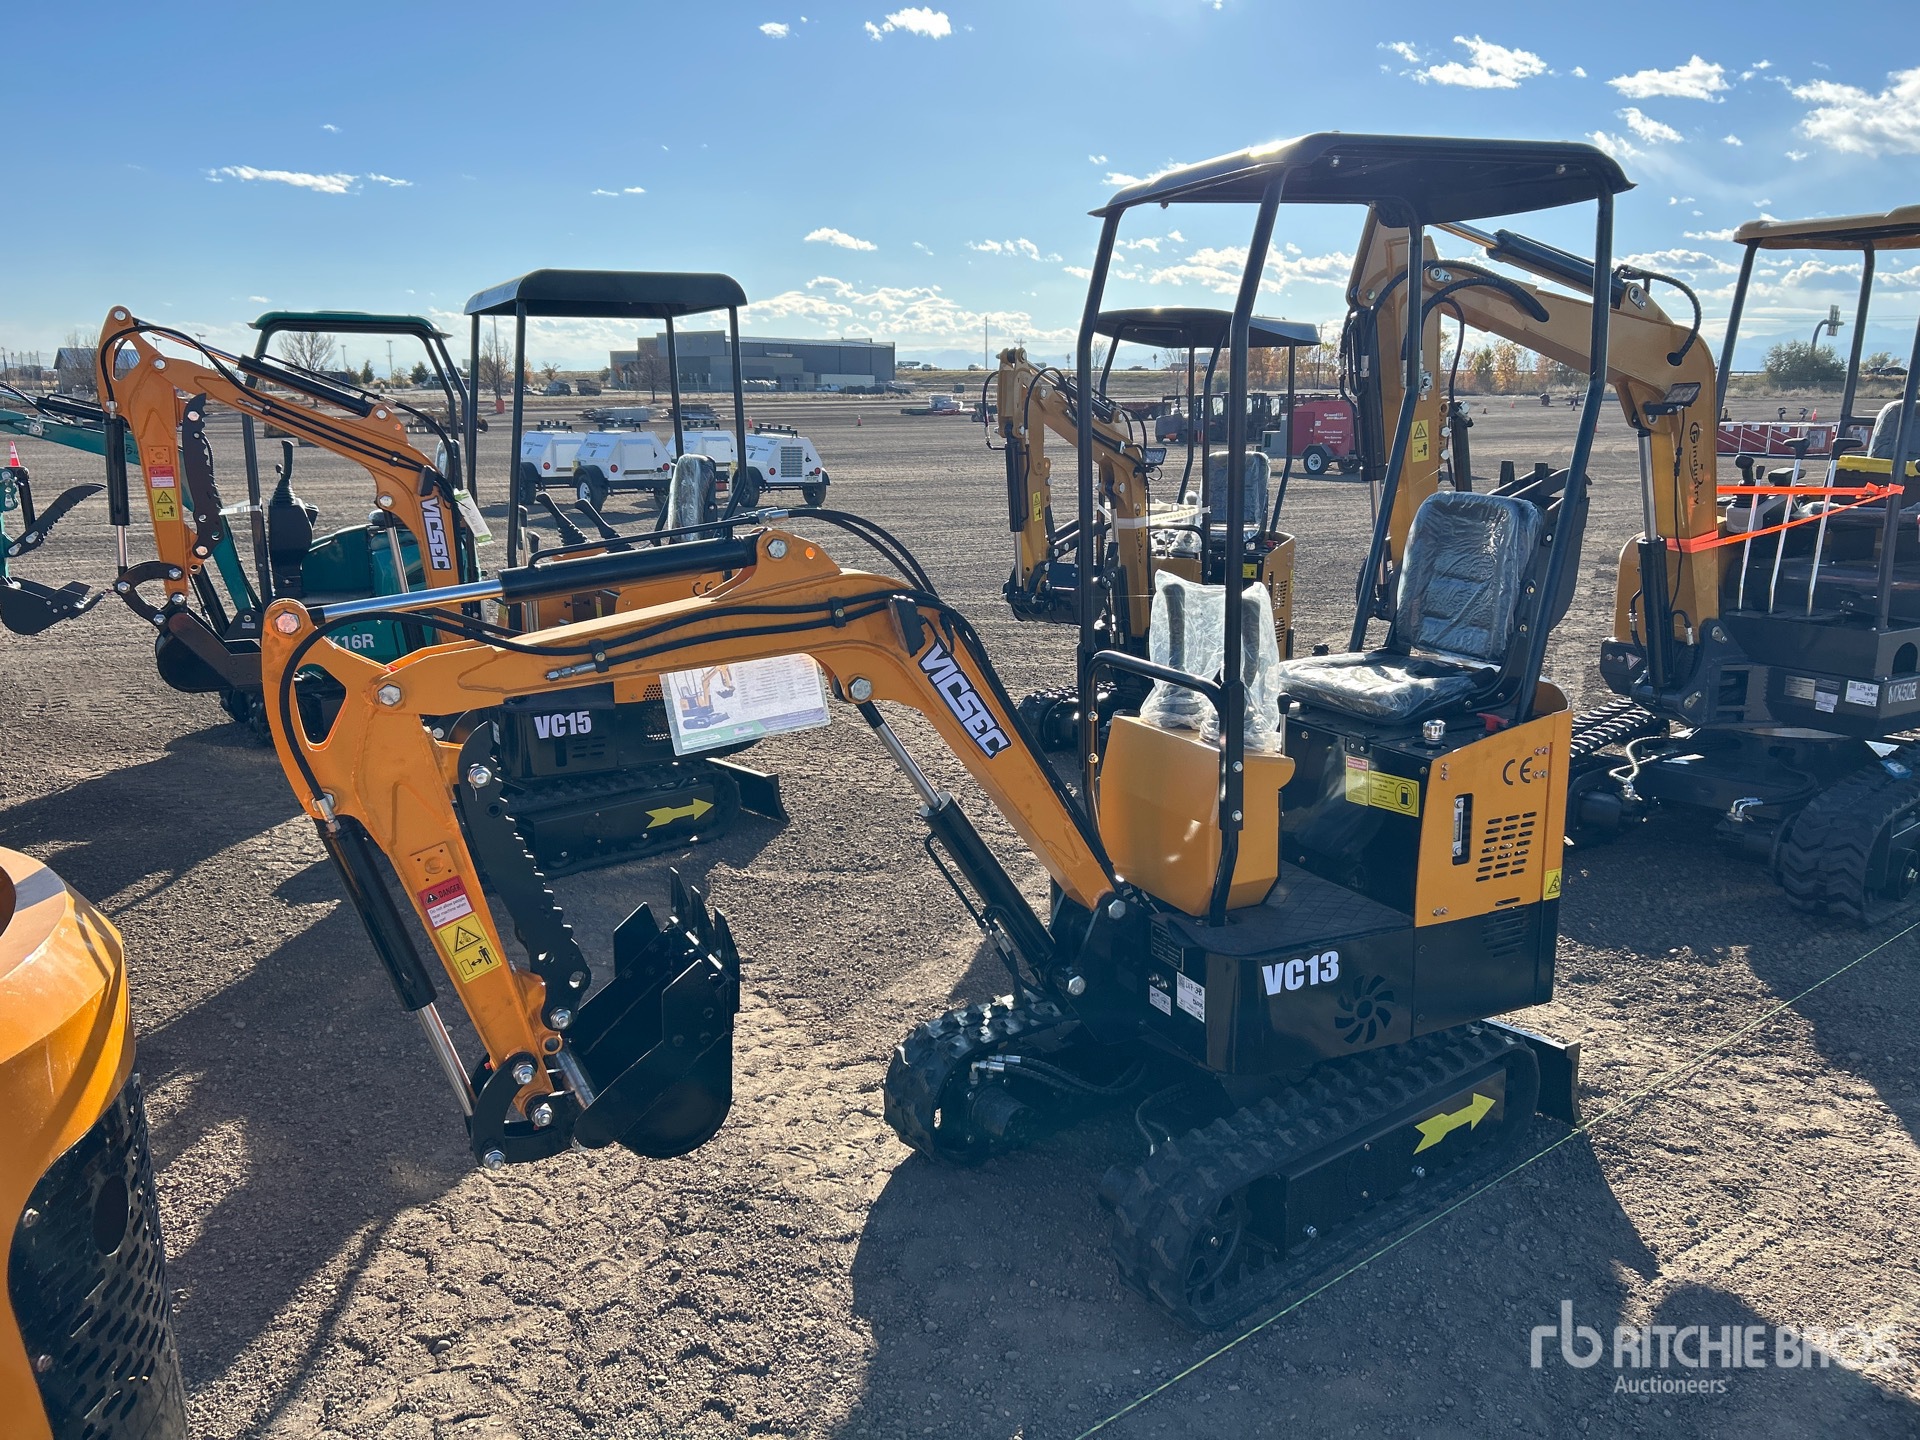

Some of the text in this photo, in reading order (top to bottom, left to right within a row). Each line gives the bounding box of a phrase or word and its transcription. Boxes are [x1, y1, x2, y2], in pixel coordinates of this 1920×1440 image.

[421, 497, 451, 569] VICSEC
[920, 642, 1009, 757] VICSEC
[534, 711, 592, 739] VC15
[1502, 757, 1533, 786] CE
[438, 884, 460, 897] DANGER
[1262, 951, 1339, 996] VC13
